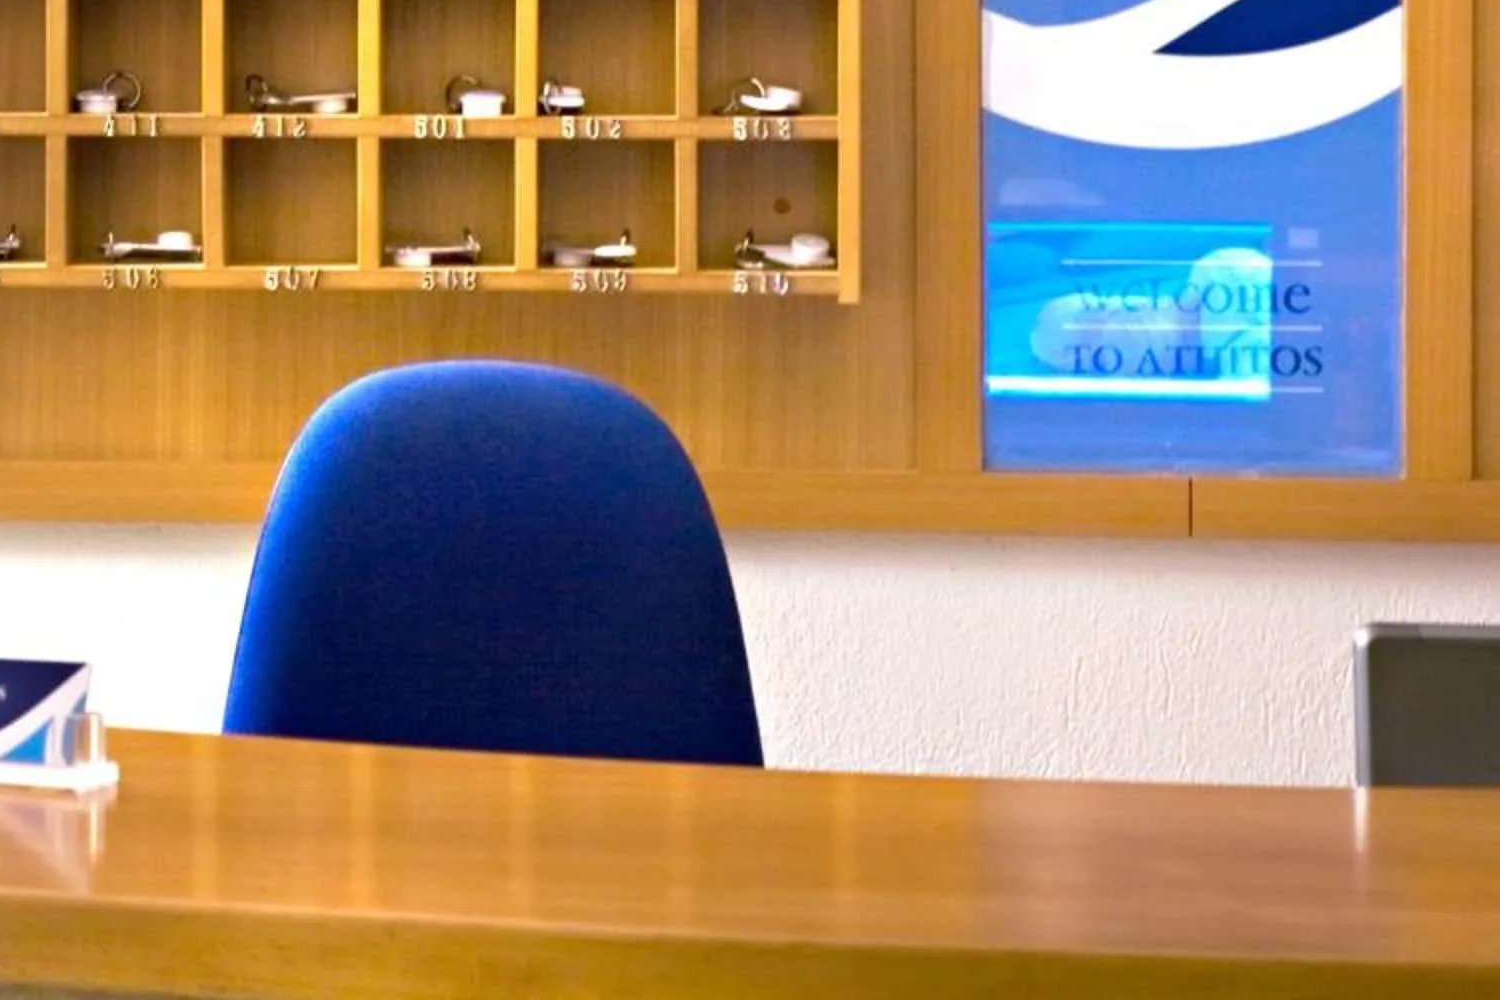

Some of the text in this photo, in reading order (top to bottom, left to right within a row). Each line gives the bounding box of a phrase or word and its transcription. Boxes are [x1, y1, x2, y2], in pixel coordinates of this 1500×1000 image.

[104, 114, 158, 138] 411
[253, 115, 306, 139] 412
[415, 115, 464, 140] 501
[562, 116, 621, 141] 502
[264, 267, 320, 291] 507
